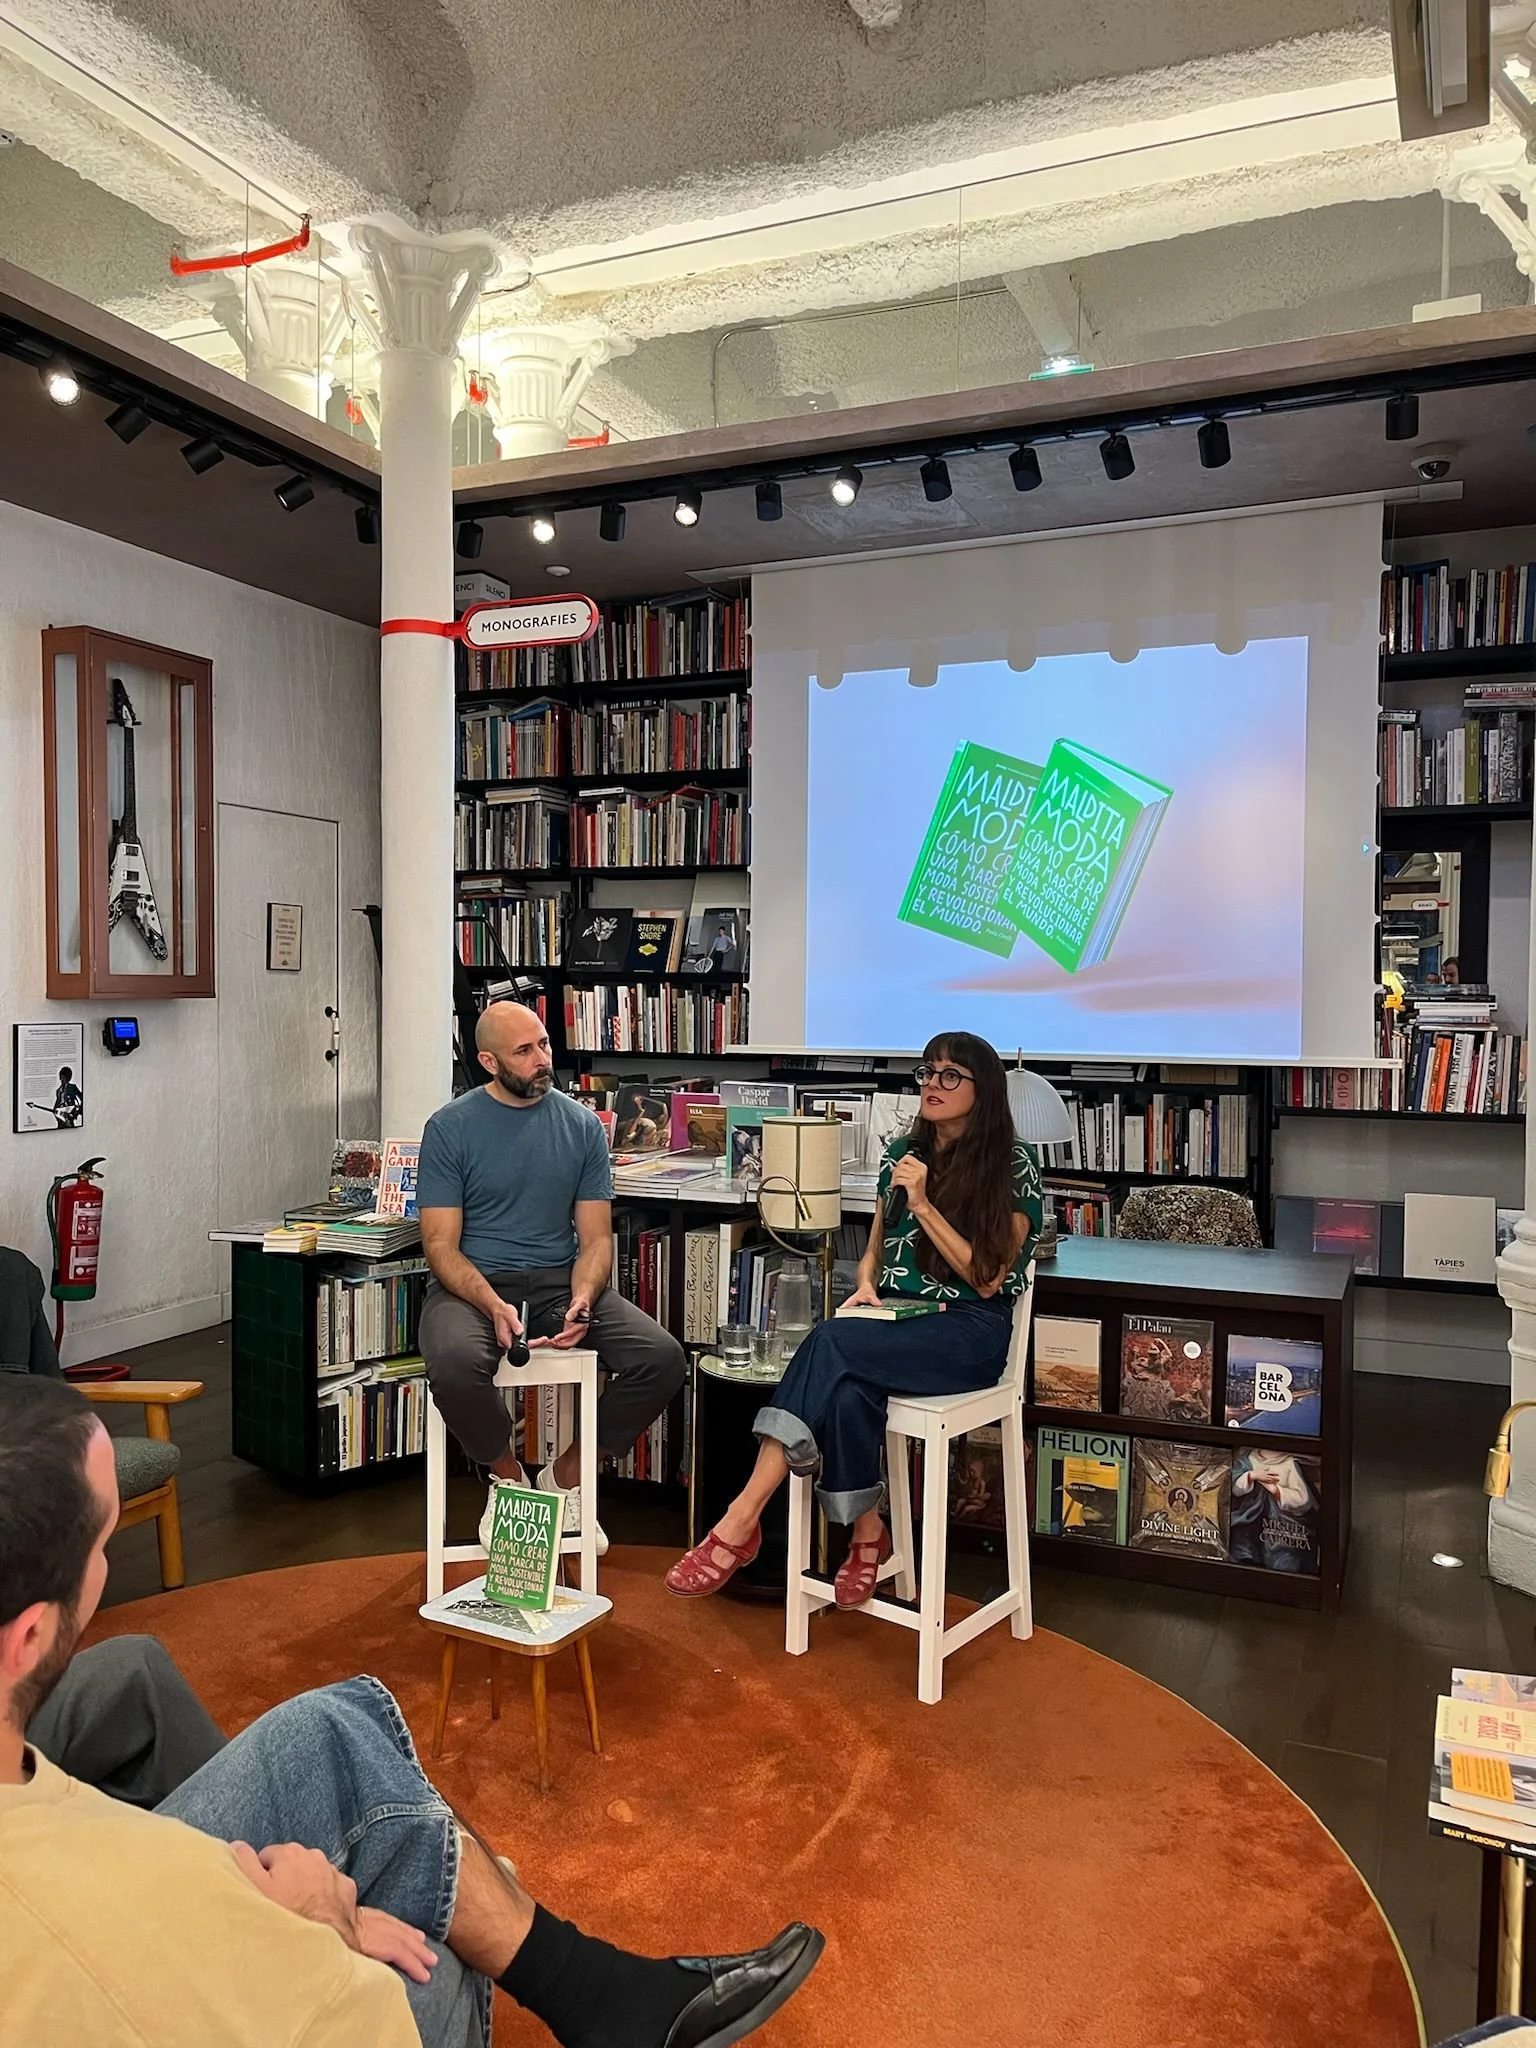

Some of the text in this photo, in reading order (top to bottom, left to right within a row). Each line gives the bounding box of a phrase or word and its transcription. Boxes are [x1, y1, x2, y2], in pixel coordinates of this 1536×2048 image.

[482, 613, 577, 632] MONOGRAFIES
[1043, 768, 1126, 850] MALDITA
[936, 831, 987, 865] CÓMO
[1031, 799, 1110, 884] MODA
[930, 851, 959, 875] UNA
[1025, 829, 1104, 903] CÓMO CREAR
[922, 868, 958, 891] MODA
[1019, 846, 1096, 916] UNA MARCA DE
[919, 884, 927, 897] Y
[1012, 860, 1089, 931] MODA SOSTENIBLE
[912, 898, 982, 934] EL MUNDO.
[1003, 887, 1014, 905] EL
[1016, 900, 1054, 940] MUNDO.
[1008, 874, 1016, 887] Y
[1015, 881, 1083, 946] REVOLUCIONAR
[637, 923, 667, 933] STEPHEN
[639, 932, 662, 940] SHORE
[738, 1086, 771, 1098] Caspar
[741, 1095, 769, 1106] David
[389, 1146, 398, 1156] A
[384, 1193, 405, 1203] THE
[385, 1183, 398, 1193] BY
[382, 1203, 403, 1213] SEA
[1128, 1318, 1172, 1334] El Palau
[1259, 1371, 1283, 1382] BAR
[1259, 1382, 1280, 1392] CEL
[1258, 1392, 1286, 1403] ONA
[497, 1496, 551, 1525] MALDITA
[494, 1517, 549, 1548] MODA
[1141, 1519, 1220, 1540] DIVINE LIGHT
[1262, 1518, 1307, 1535] MIGUEL
[492, 1536, 549, 1562] CÓMO CREAR
[1259, 1533, 1311, 1550] CABRERA
[491, 1552, 547, 1572] UNA MARCA DE
[489, 1562, 545, 1584] MODA SOSTENIBLE
[489, 1573, 545, 1593] Y REVOLUCIONAR
[487, 1582, 494, 1593] EL
